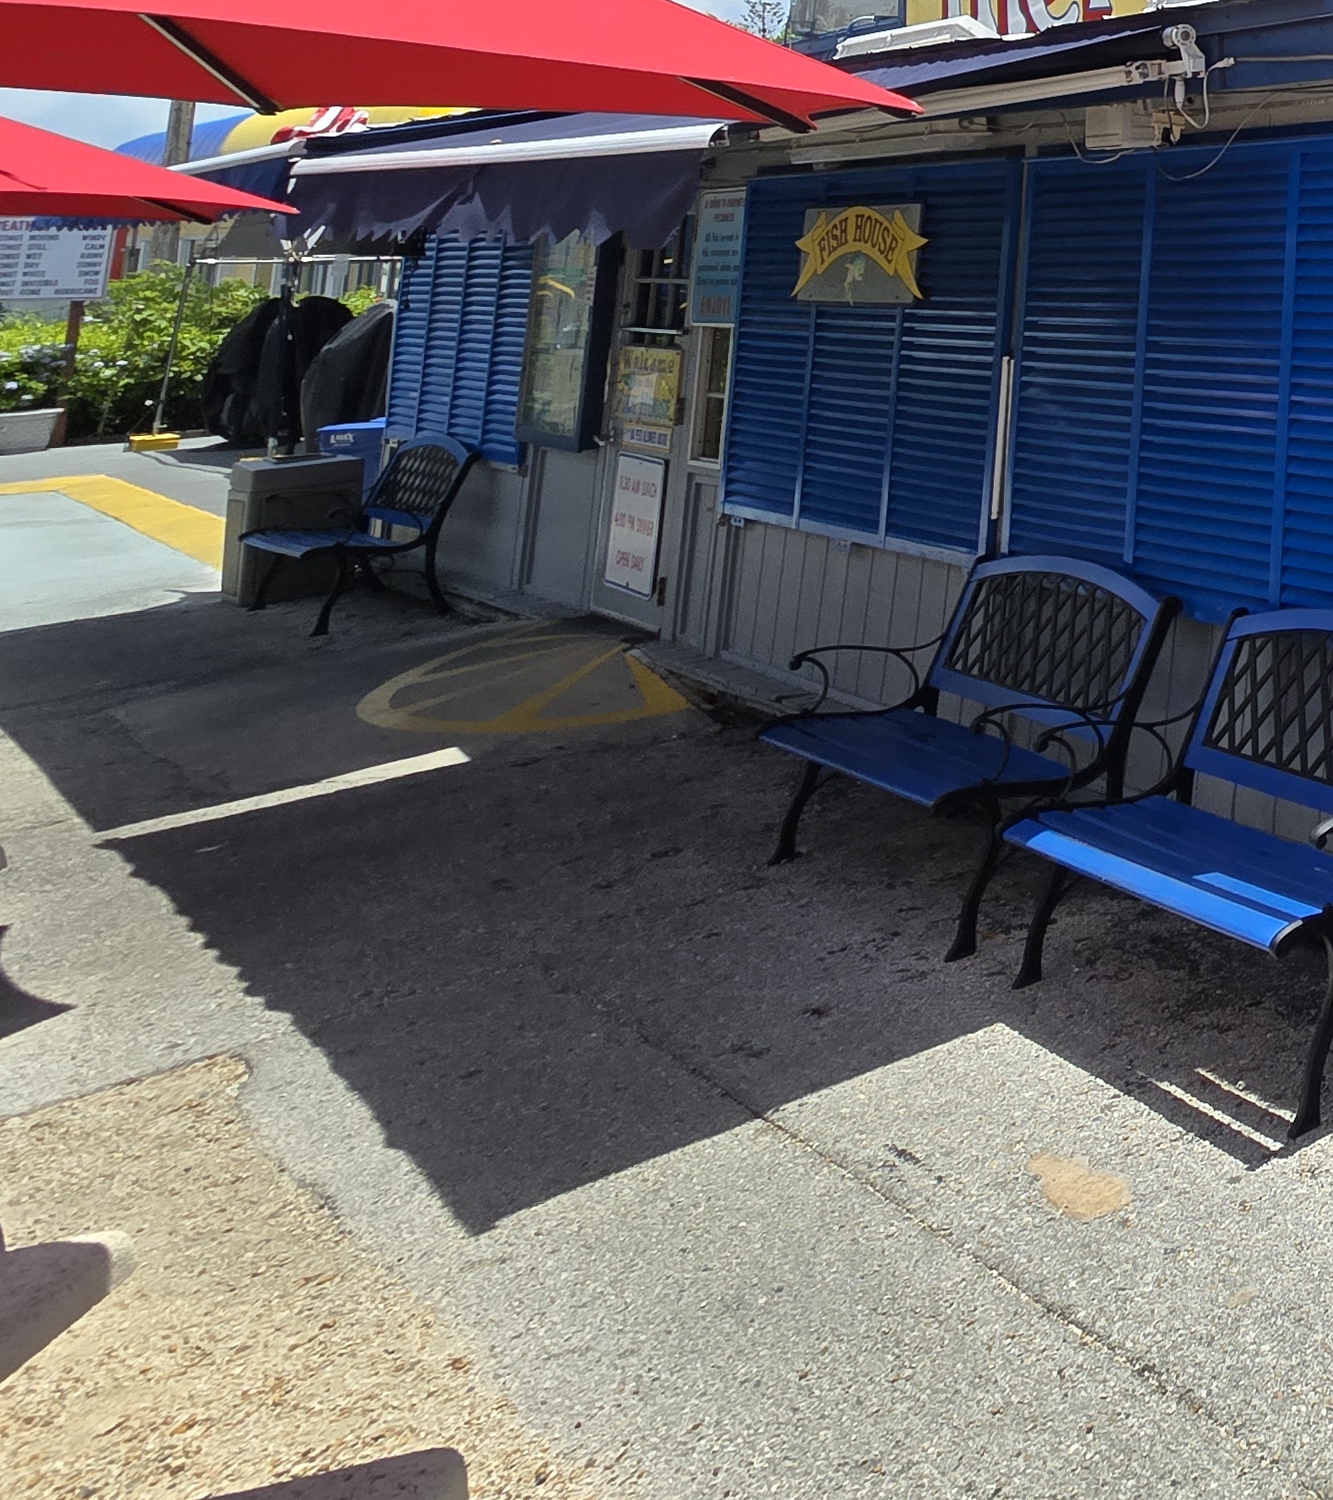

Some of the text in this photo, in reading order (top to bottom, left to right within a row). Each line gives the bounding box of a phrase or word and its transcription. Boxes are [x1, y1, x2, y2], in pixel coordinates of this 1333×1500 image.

[84, 243, 105, 251] CALM
[817, 213, 899, 266] FISH HOUSE
